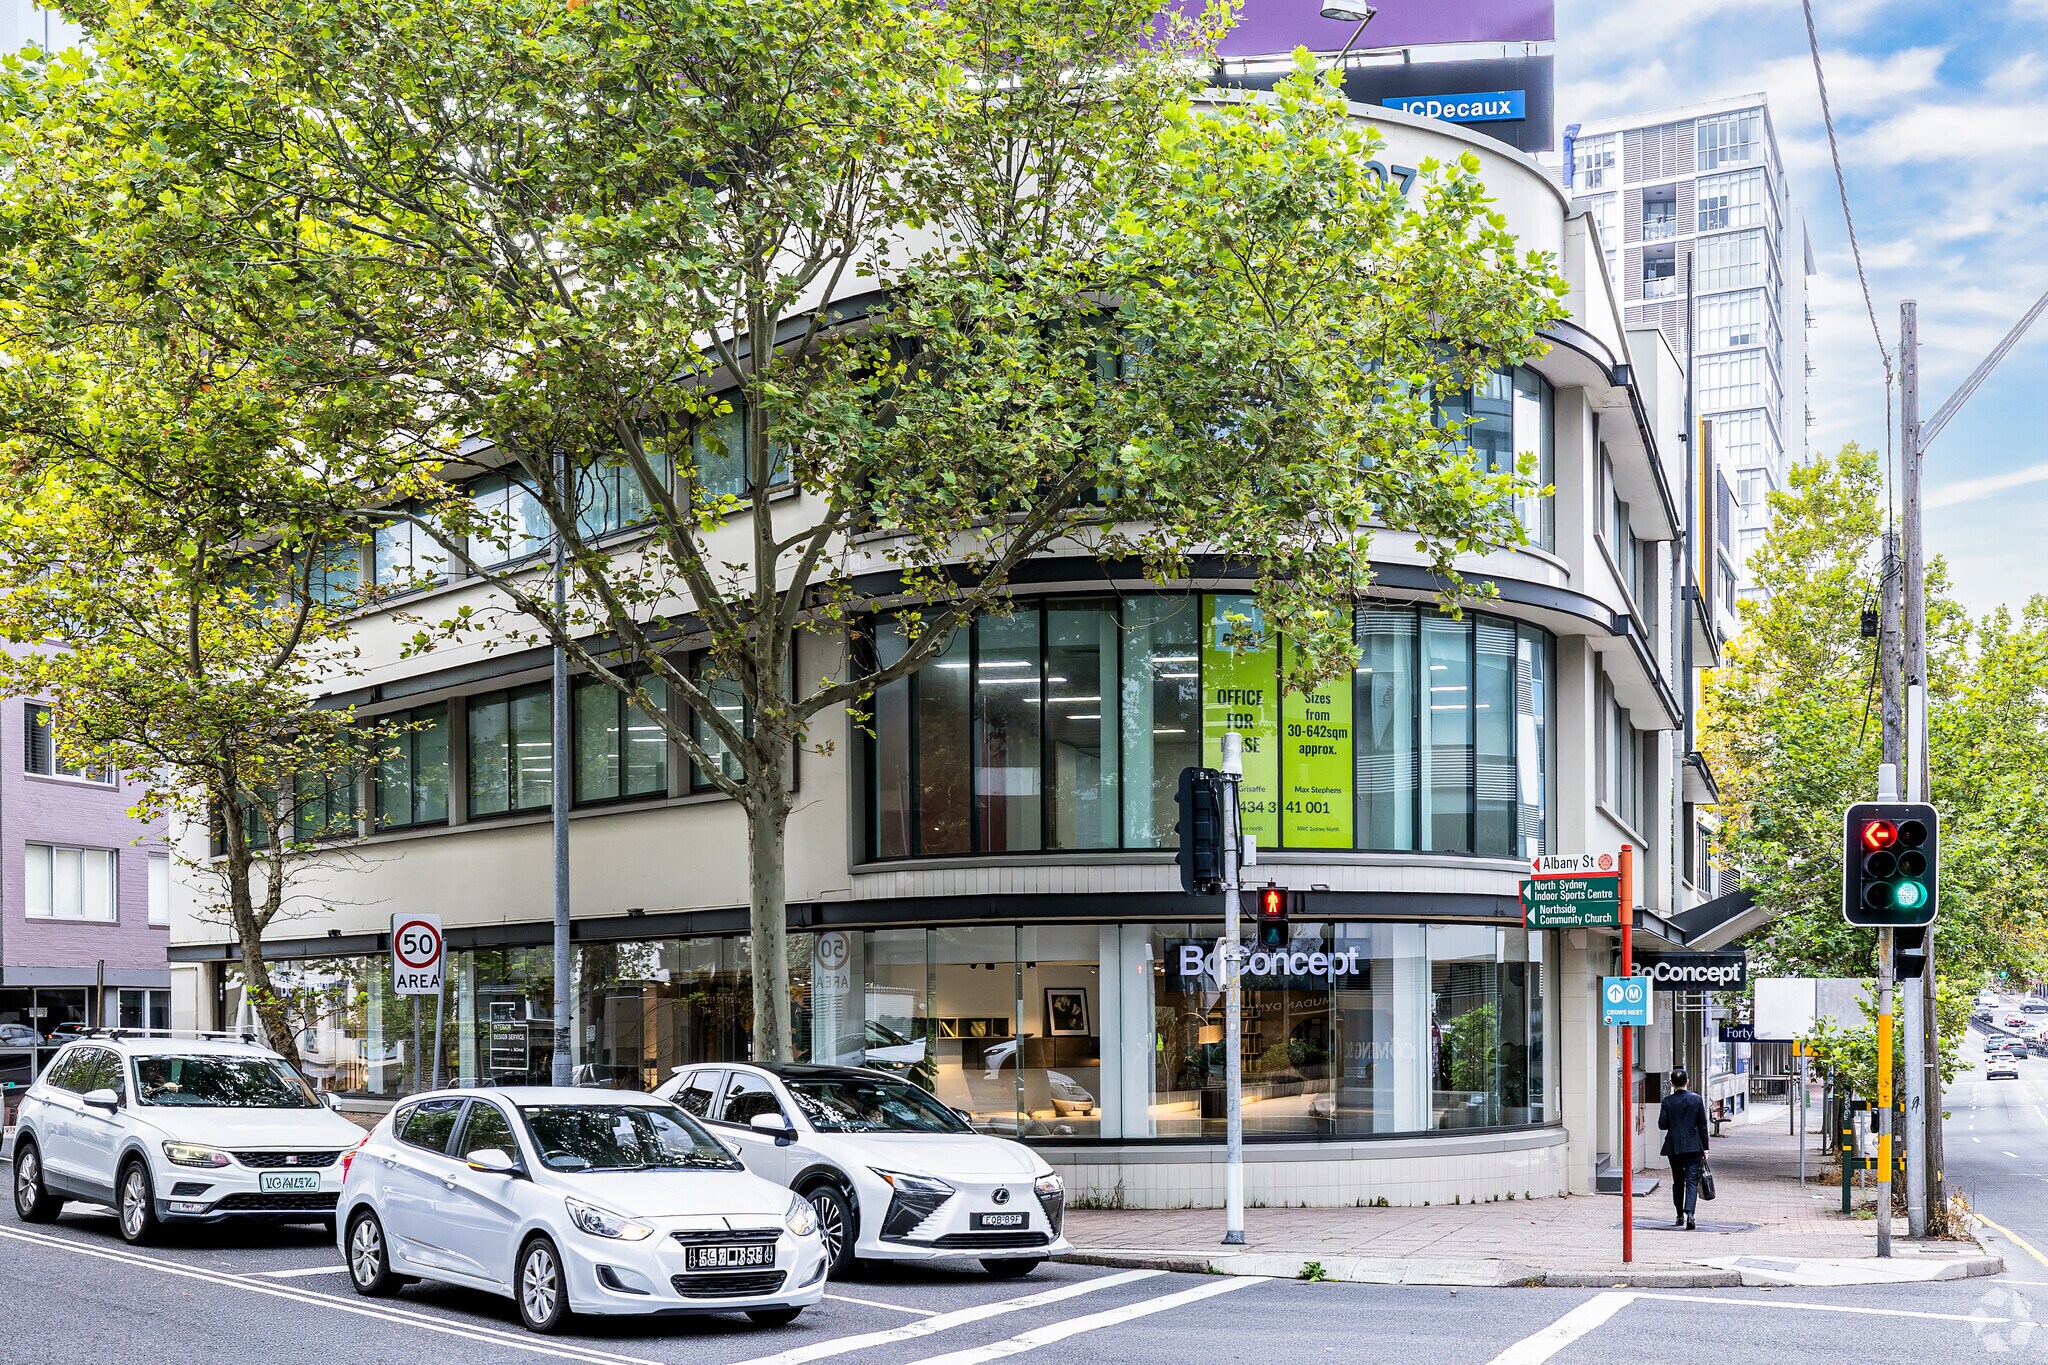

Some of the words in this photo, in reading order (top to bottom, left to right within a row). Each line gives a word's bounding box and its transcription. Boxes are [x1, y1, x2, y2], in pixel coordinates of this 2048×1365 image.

[1217, 689, 1264, 706] OFFICE
[1305, 693, 1331, 705] Sizes
[1227, 713, 1254, 729] FOR
[1305, 709, 1331, 721] from
[1287, 724, 1348, 741] 30-642sqm
[1299, 744, 1337, 757] approx.
[1294, 786, 1310, 794] Max
[1311, 786, 1342, 795] Stephens
[1268, 801, 1277, 814] 3
[1285, 801, 1302, 814] 41
[1305, 801, 1330, 815] 001
[1543, 856, 1579, 872] Albany
[1582, 854, 1595, 868] St
[1534, 881, 1556, 891] North
[1559, 880, 1588, 892] Sydney
[1534, 891, 1559, 901] Indoor
[1560, 890, 1586, 902] Sports
[1587, 889, 1613, 899] Centre
[1540, 904, 1577, 915] Northside
[1540, 914, 1583, 925] Community
[1584, 912, 1612, 923] Church
[404, 933, 433, 955] 50
[396, 974, 440, 989] AREA
[1726, 1026, 1754, 1041] Forty
